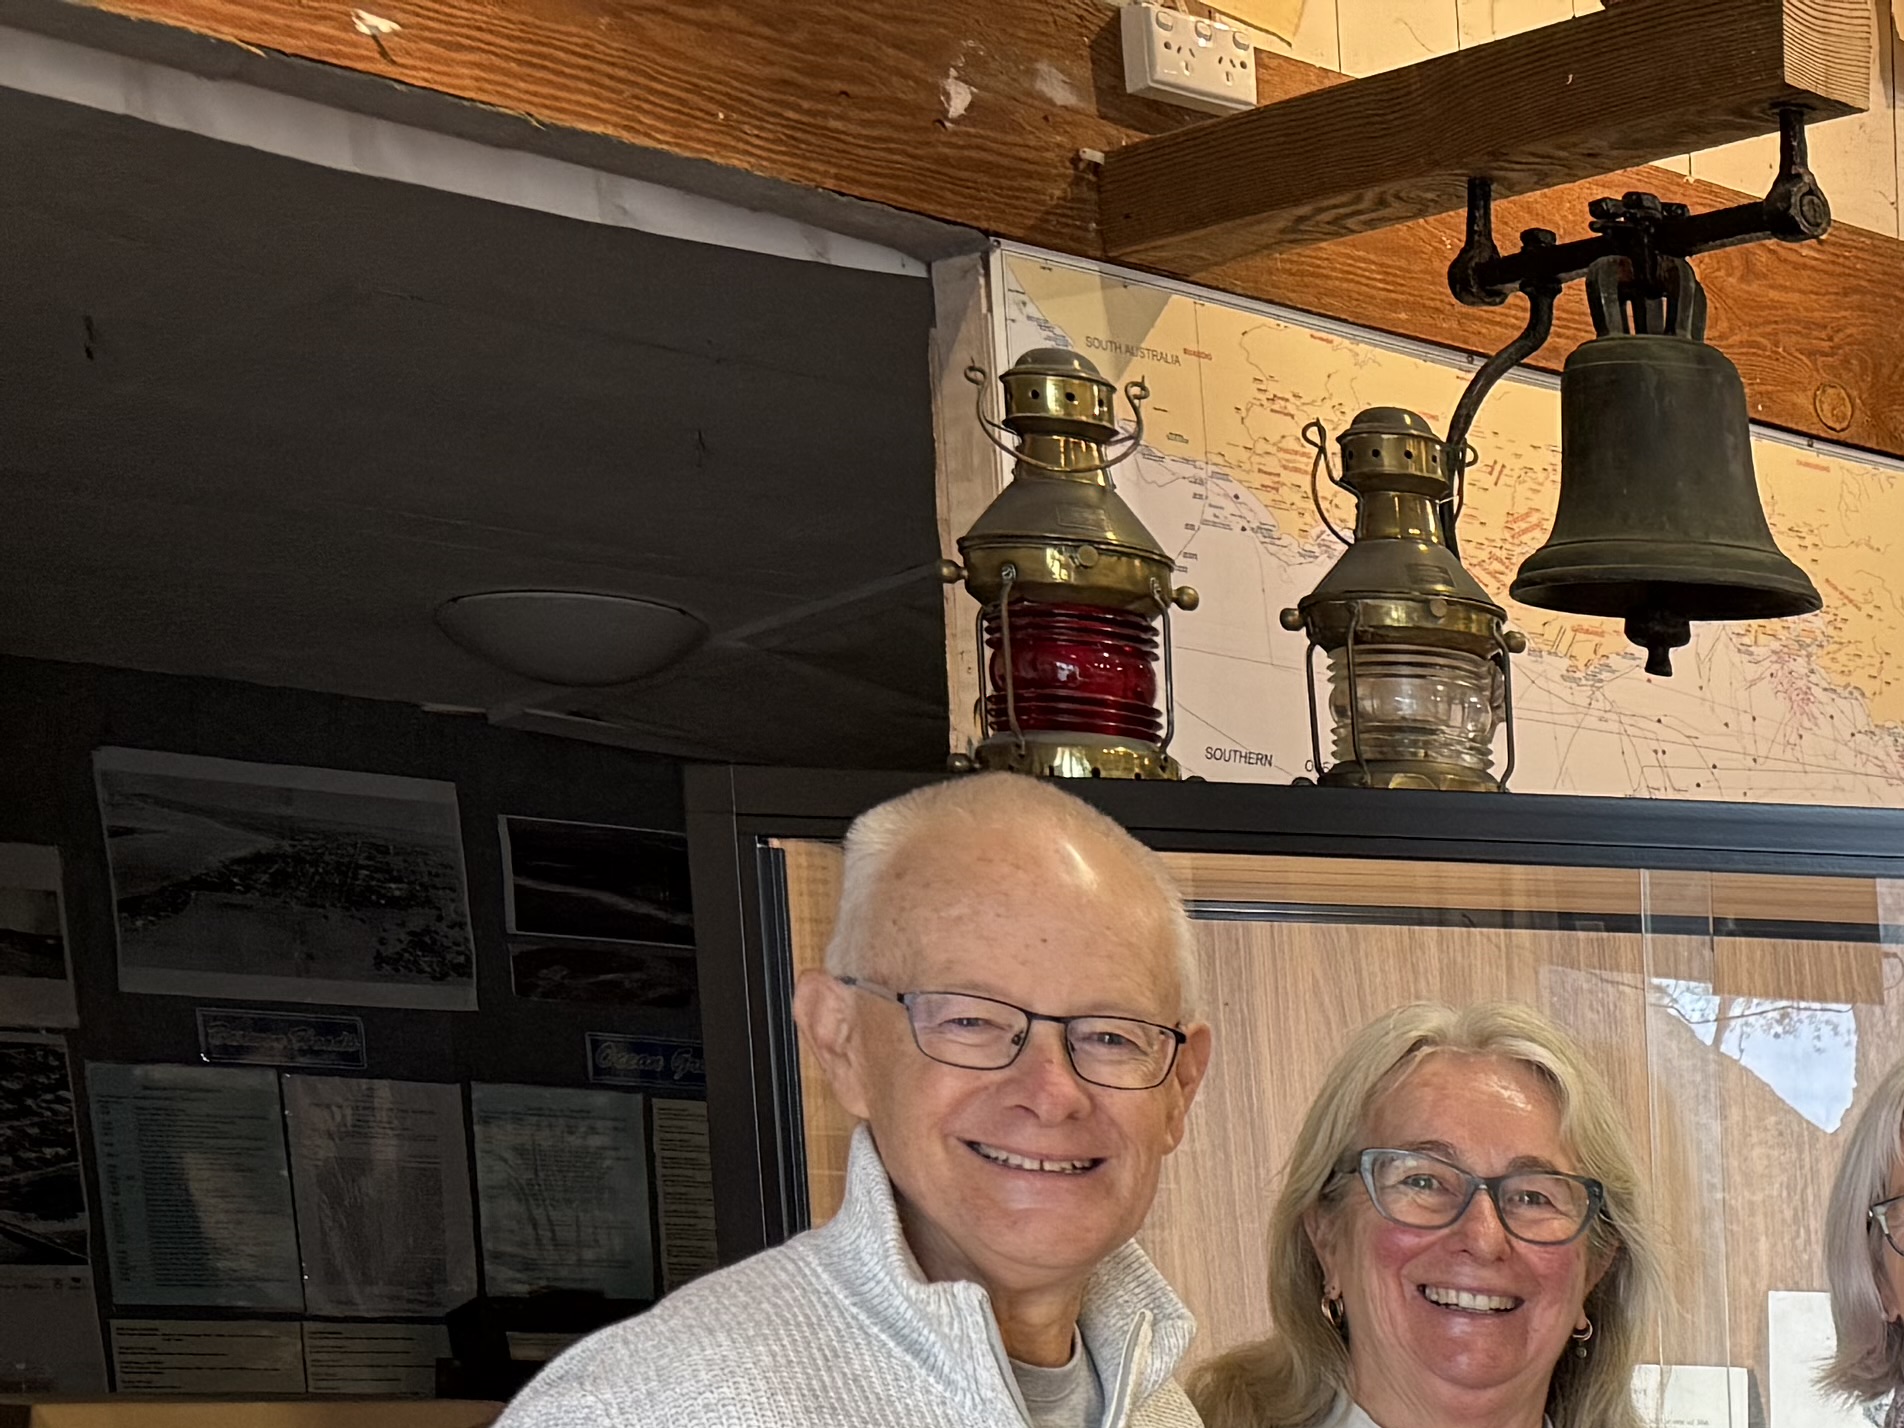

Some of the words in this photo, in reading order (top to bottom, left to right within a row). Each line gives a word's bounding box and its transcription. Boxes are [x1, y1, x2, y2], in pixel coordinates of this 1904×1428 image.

[1085, 335, 1123, 355] SOUTH
[1123, 345, 1182, 367] AUSTRALIA
[1205, 746, 1274, 768] SOUTHERN
